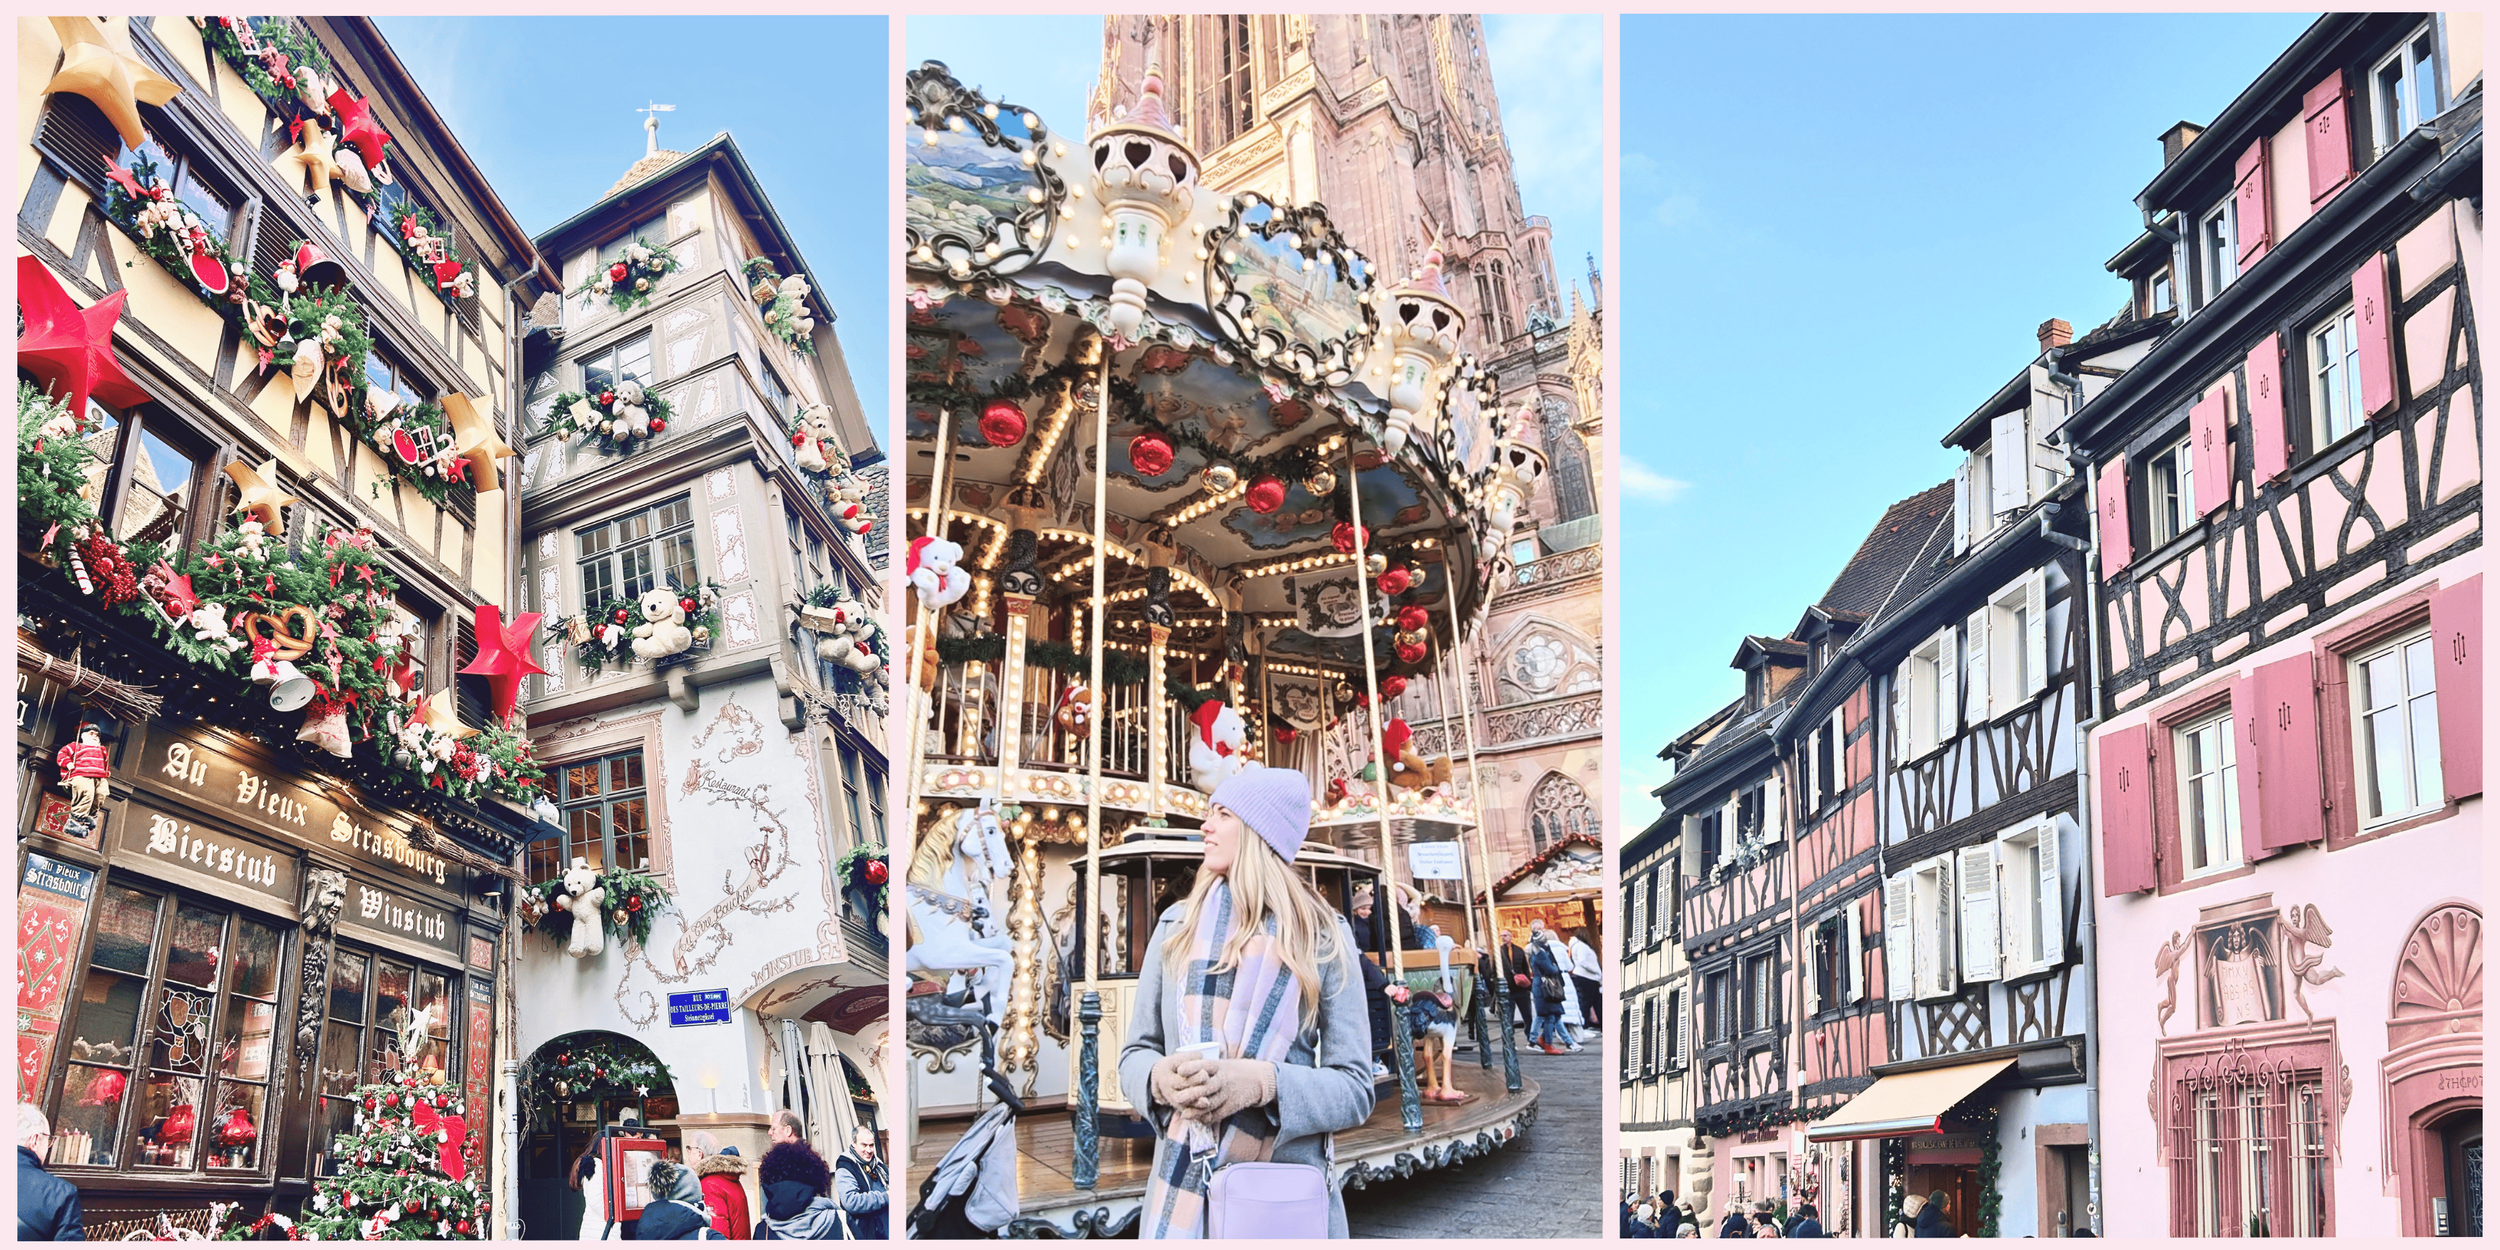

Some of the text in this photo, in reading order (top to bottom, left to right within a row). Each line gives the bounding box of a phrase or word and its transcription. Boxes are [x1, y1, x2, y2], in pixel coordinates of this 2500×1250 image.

[699, 769, 752, 799] Restaurant
[162, 742, 446, 885] Au Vieux Strasbourg
[146, 814, 277, 888] Bierstub
[25, 867, 89, 900] Strasbourg
[359, 885, 446, 942] Winstub
[750, 947, 814, 987] WINSTUB
